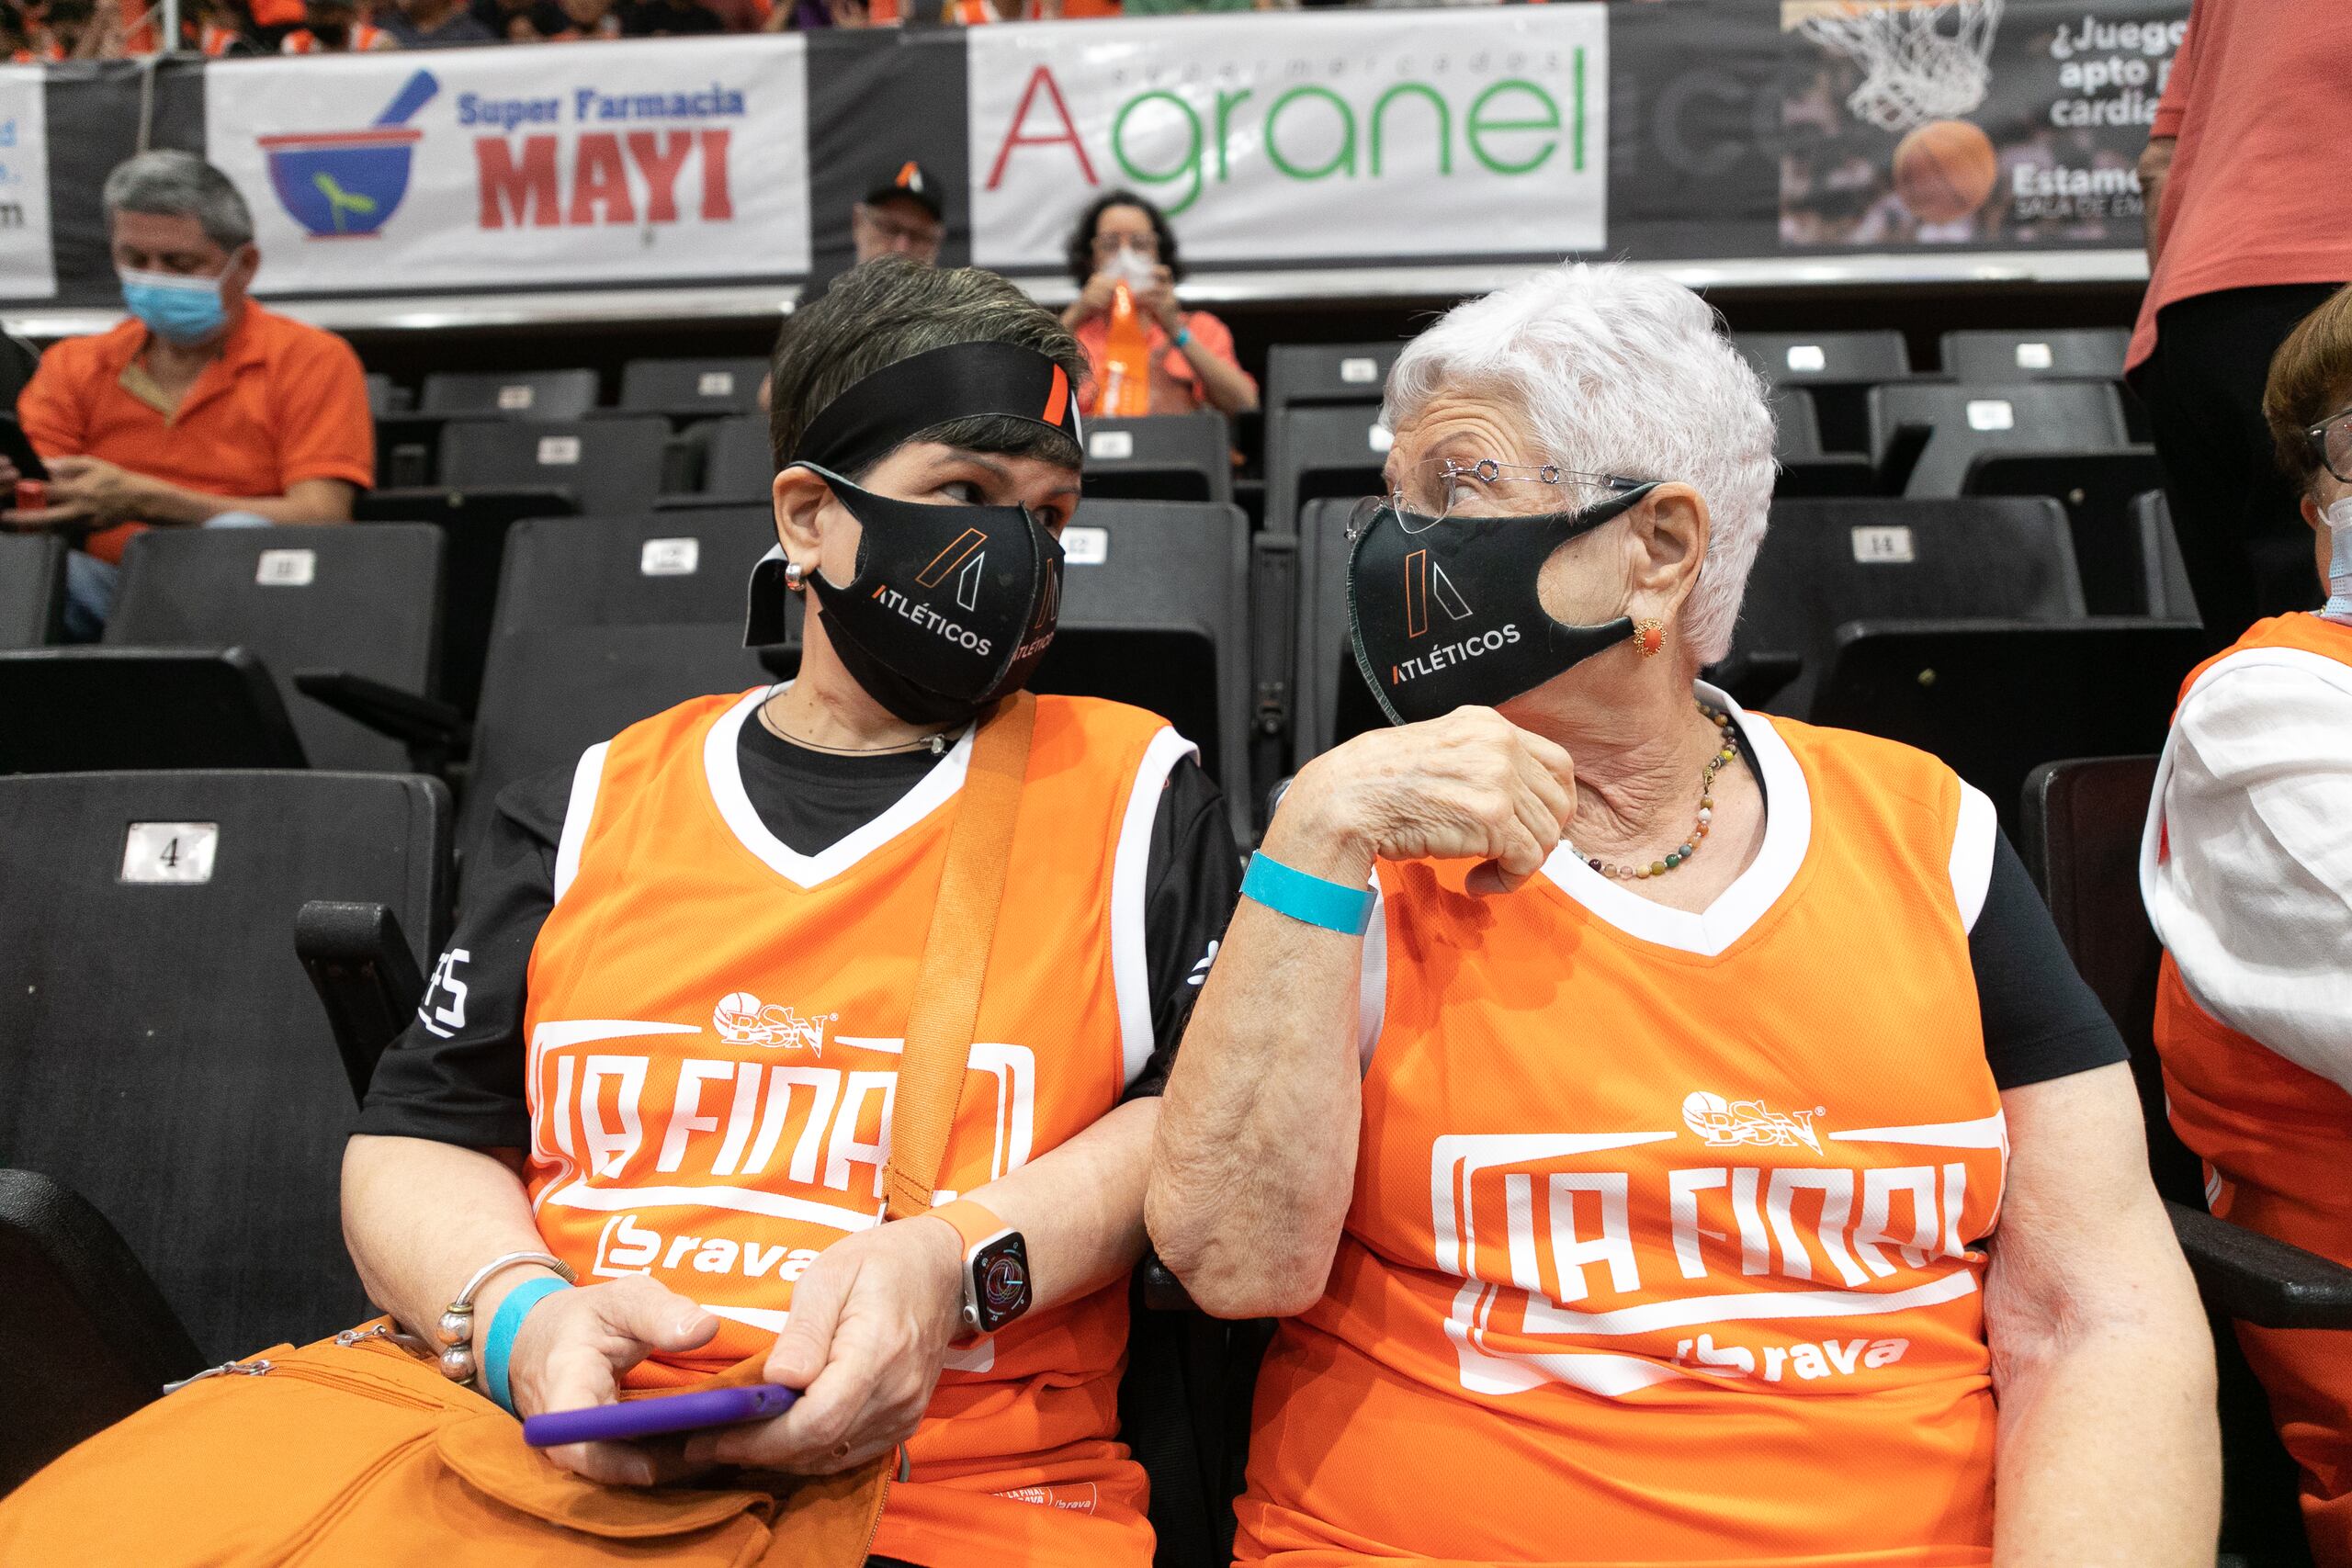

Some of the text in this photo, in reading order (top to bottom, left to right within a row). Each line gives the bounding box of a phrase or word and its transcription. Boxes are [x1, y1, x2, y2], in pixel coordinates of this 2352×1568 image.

[2059, 55, 2151, 96] apto
[456, 82, 746, 131] Super Farmacia
[985, 43, 1586, 220] Agranel
[472, 129, 735, 230] MAYI
[872, 584, 992, 657] ATLÉTICOS
[1393, 624, 1521, 685] ATLÉTICOS
[159, 837, 180, 868] 4
